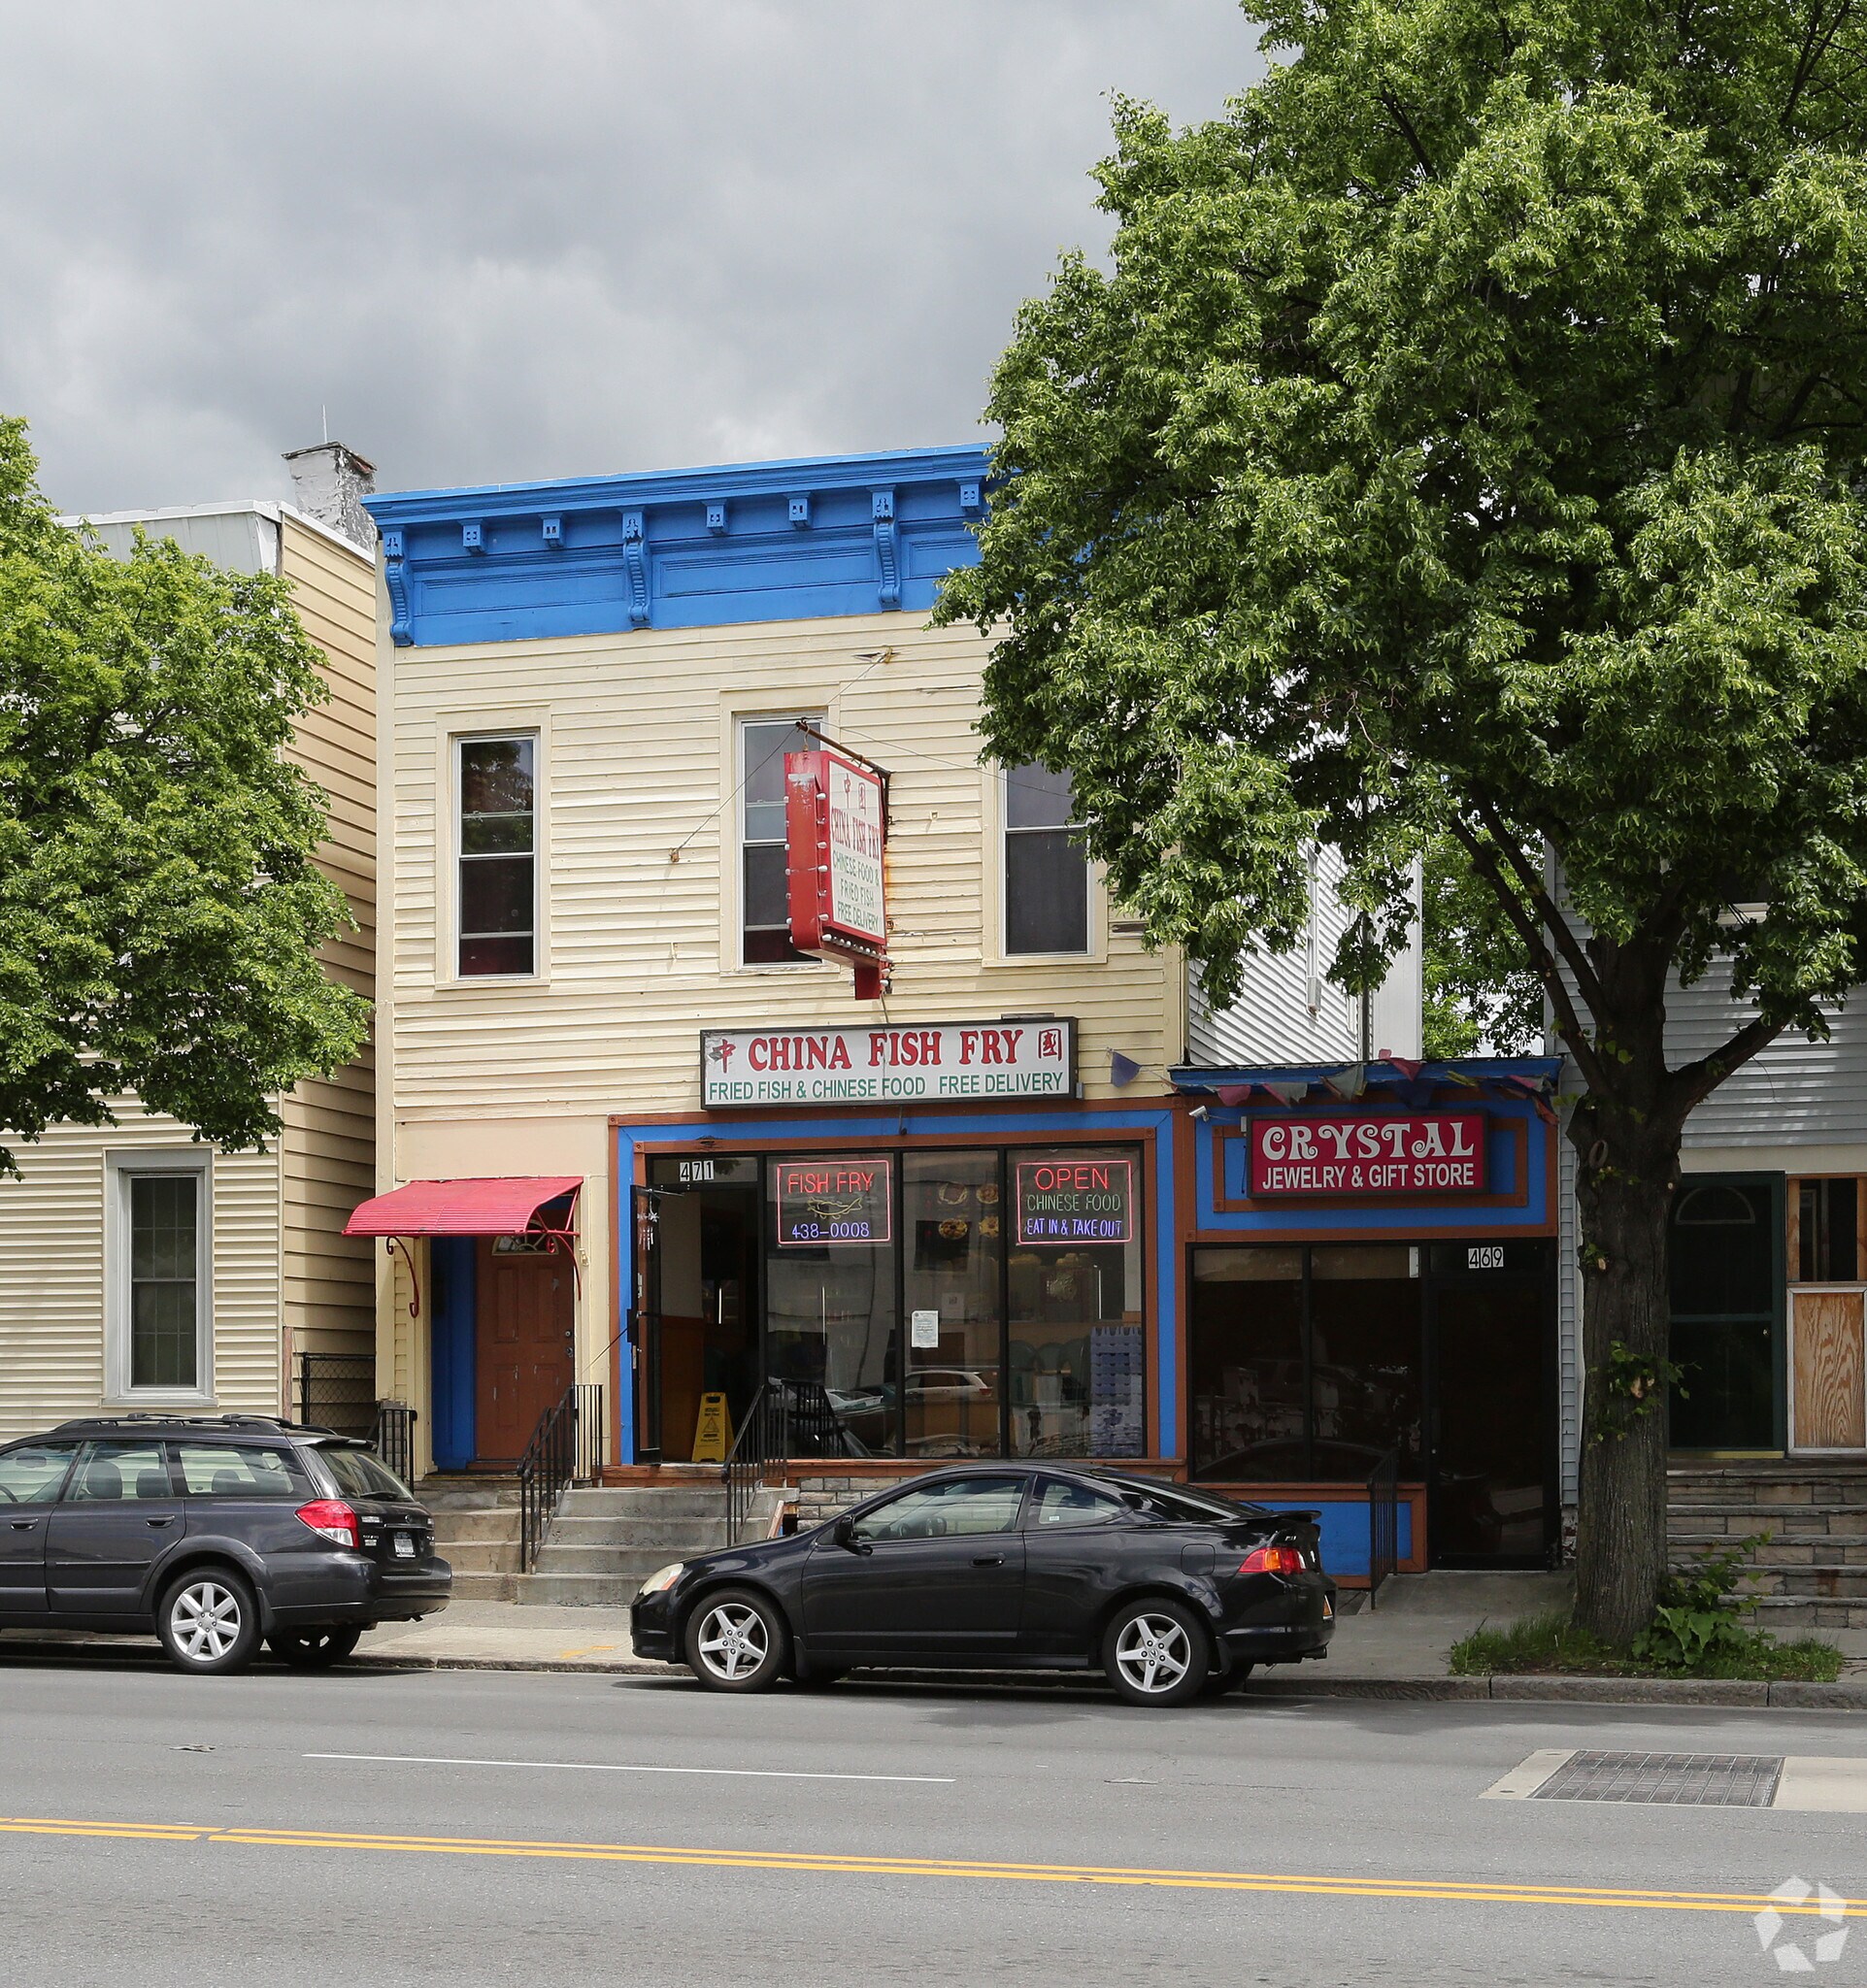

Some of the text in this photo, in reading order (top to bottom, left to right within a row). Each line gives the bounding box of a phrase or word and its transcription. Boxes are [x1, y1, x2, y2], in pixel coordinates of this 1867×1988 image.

[832, 806, 880, 860] CHINA FISH FRY
[833, 850, 879, 886] CHINESE FOOD &
[841, 878, 874, 908] FRIED FISH
[838, 901, 878, 932] FREE DELIVERY
[748, 1029, 1024, 1071] CHINA FISH FRY
[709, 1072, 1063, 1101] FRIED FISH & CHINESE FOOD FREE DELIVERY
[1262, 1122, 1474, 1161] CRYSTAL
[681, 1161, 715, 1181] 471
[787, 1171, 873, 1194] FISH FRY
[1035, 1167, 1110, 1190] OPEN
[1262, 1164, 1474, 1189] JEWELRY & GIFT STORE
[1026, 1193, 1120, 1211] CHINESE FOOD
[791, 1222, 870, 1240] 438-0008
[1025, 1218, 1121, 1237] EAT IN & TAKE OUT
[1468, 1246, 1504, 1269] 469
